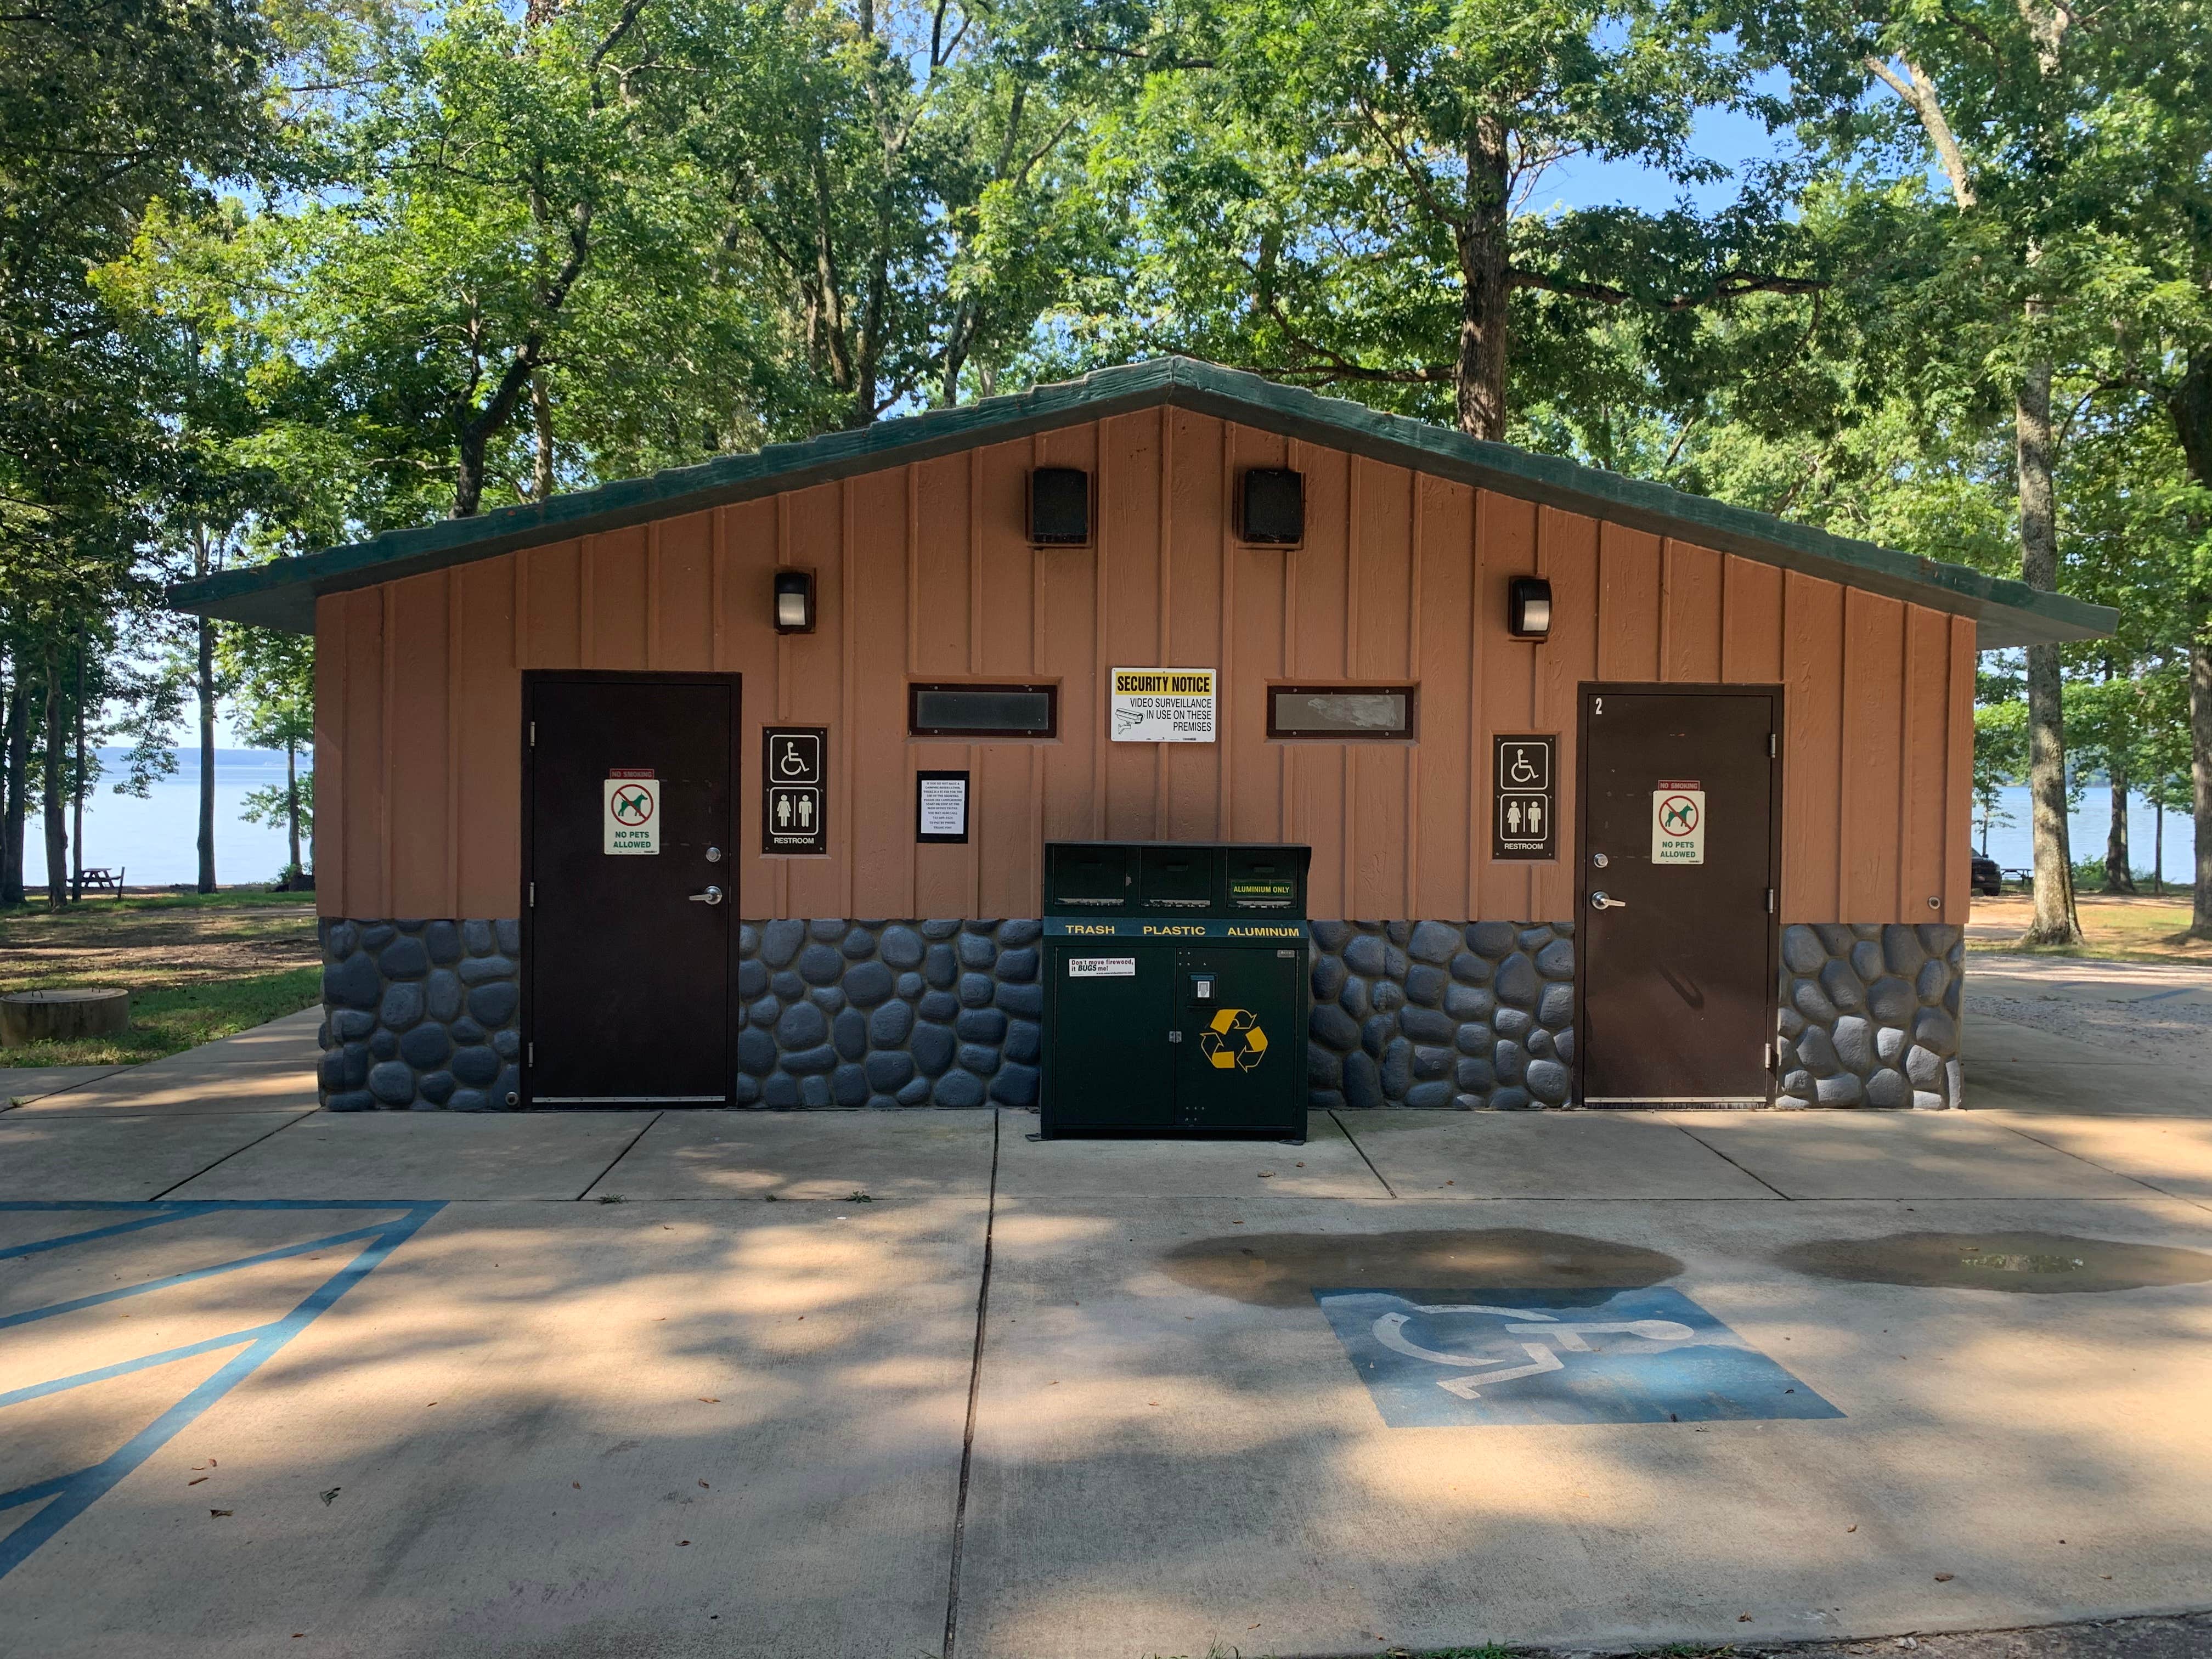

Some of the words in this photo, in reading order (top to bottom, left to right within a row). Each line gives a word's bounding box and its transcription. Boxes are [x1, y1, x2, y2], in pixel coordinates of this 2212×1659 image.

[1118, 676, 1169, 691] SECURITY
[1172, 677, 1210, 692] NOTICE
[1130, 698, 1153, 707] VIDEO
[1155, 698, 1211, 708] SURVEILLANCE
[1595, 698, 1602, 714] 2
[1147, 710, 1153, 719] IN
[1156, 710, 1171, 719] USE
[1173, 710, 1184, 719] ON
[1188, 710, 1211, 719] THESE
[1173, 722, 1211, 731] PREMISES
[1065, 925, 1115, 934] TRASH
[1143, 926, 1206, 935] PLASTIC
[1227, 927, 1299, 936] ALUMINUM
